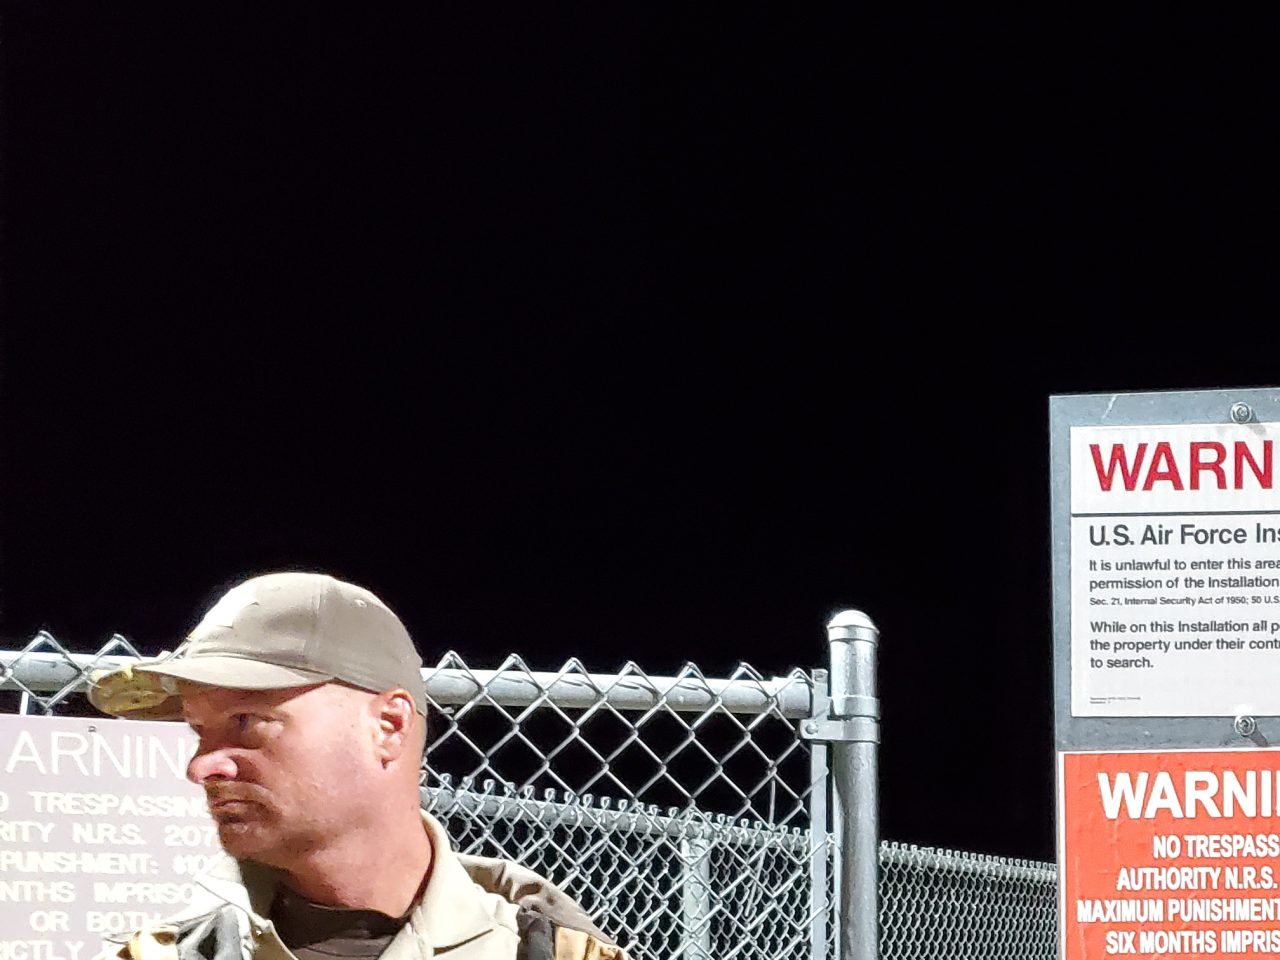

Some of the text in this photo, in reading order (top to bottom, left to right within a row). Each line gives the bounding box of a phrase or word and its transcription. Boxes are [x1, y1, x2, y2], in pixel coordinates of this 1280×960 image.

[1090, 524, 1134, 546] U.S.
[1141, 524, 1173, 545] Air
[1181, 524, 1247, 544] Force
[1090, 560, 1097, 571] It
[1101, 560, 1111, 571] is
[1116, 559, 1170, 570] unlawful
[1174, 560, 1186, 570] to
[1191, 559, 1224, 570] enter
[1228, 558, 1251, 569] this
[1090, 578, 1162, 592] permission
[1166, 577, 1179, 588] of
[1184, 577, 1204, 588] the
[1209, 576, 1279, 588] Installation
[1160, 597, 1196, 606] Security
[1227, 596, 1248, 604] 1950;
[1091, 621, 1126, 632] While
[1130, 624, 1146, 632] on
[1150, 621, 1174, 632] this
[1179, 620, 1249, 632] Installation
[1253, 620, 1267, 631] all
[1090, 639, 1110, 650] the
[1114, 640, 1170, 653] property
[1175, 639, 1212, 649] under
[1216, 638, 1245, 649] their
[1091, 657, 1153, 668] to search.
[1154, 836, 1180, 858] NO
[0, 850, 159, 875] PUNISHMENT:
[1117, 867, 1220, 890] AUTHORITY
[1226, 867, 1277, 889] N.R.S.
[93, 881, 194, 904] IMPRISO
[30, 910, 70, 933] OR
[1077, 900, 1163, 922] MAXIMUM
[1107, 931, 1136, 953] SIX
[1140, 931, 1216, 953] MONTHS
